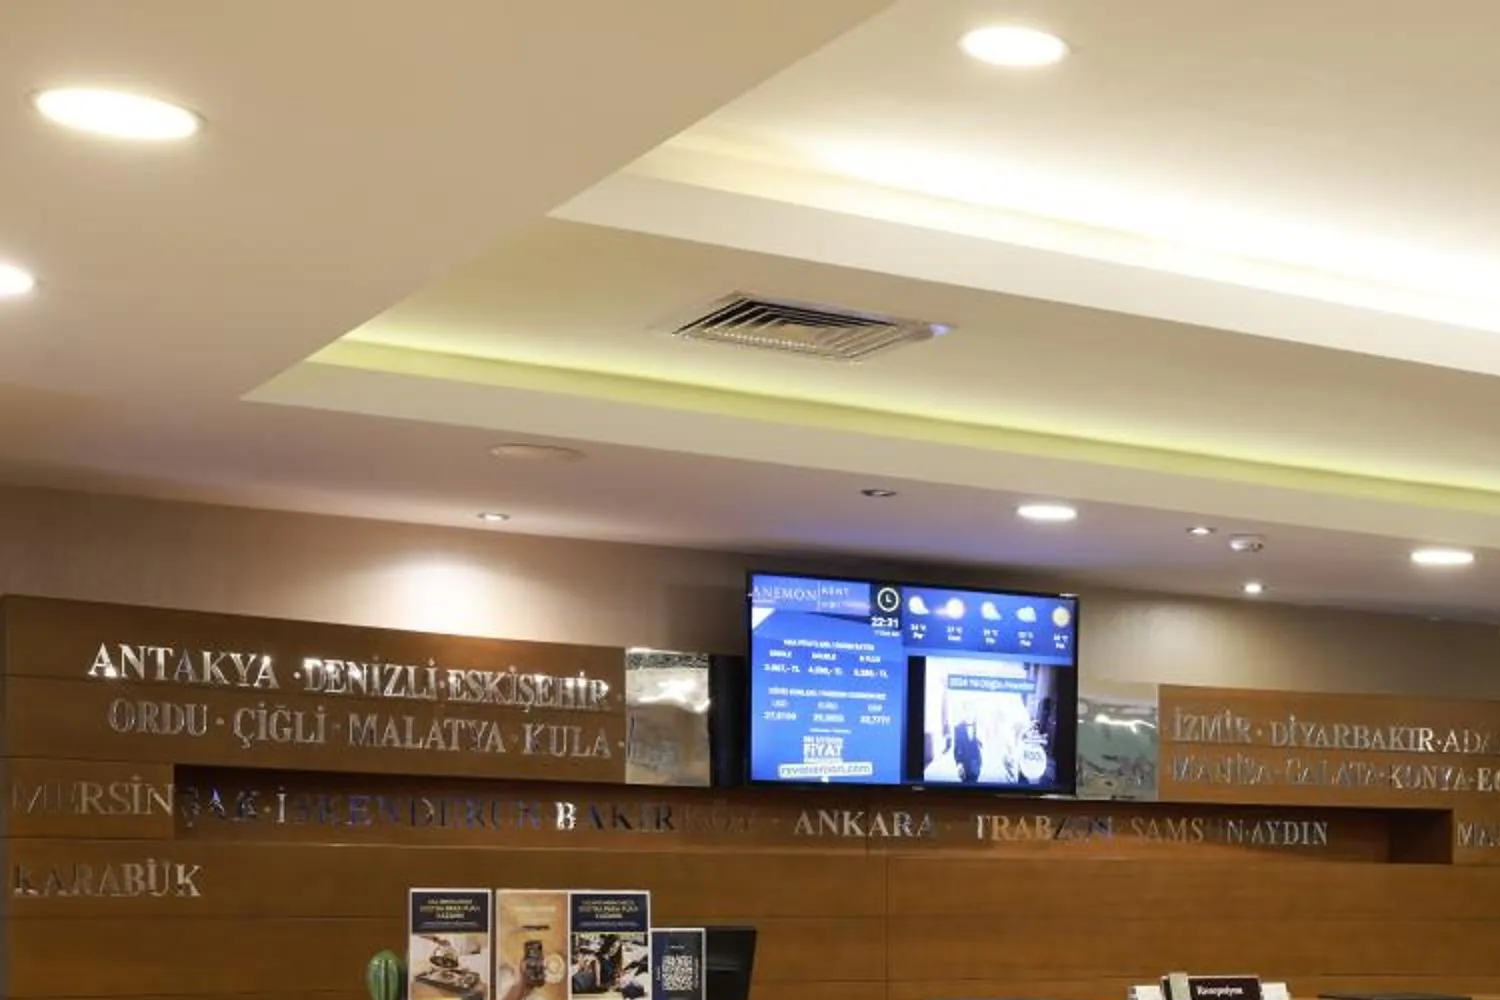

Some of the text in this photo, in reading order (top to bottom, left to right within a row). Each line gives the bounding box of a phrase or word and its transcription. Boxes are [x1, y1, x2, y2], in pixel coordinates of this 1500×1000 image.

[87, 641, 280, 689] ANTAKYA
[108, 698, 611, 758] ORDU ÇİĞLİ MALATYA KULA
[794, 808, 934, 838] ANKARA
[1130, 815, 1242, 846] SAMSN
[1250, 820, 1328, 847] AYDIN
